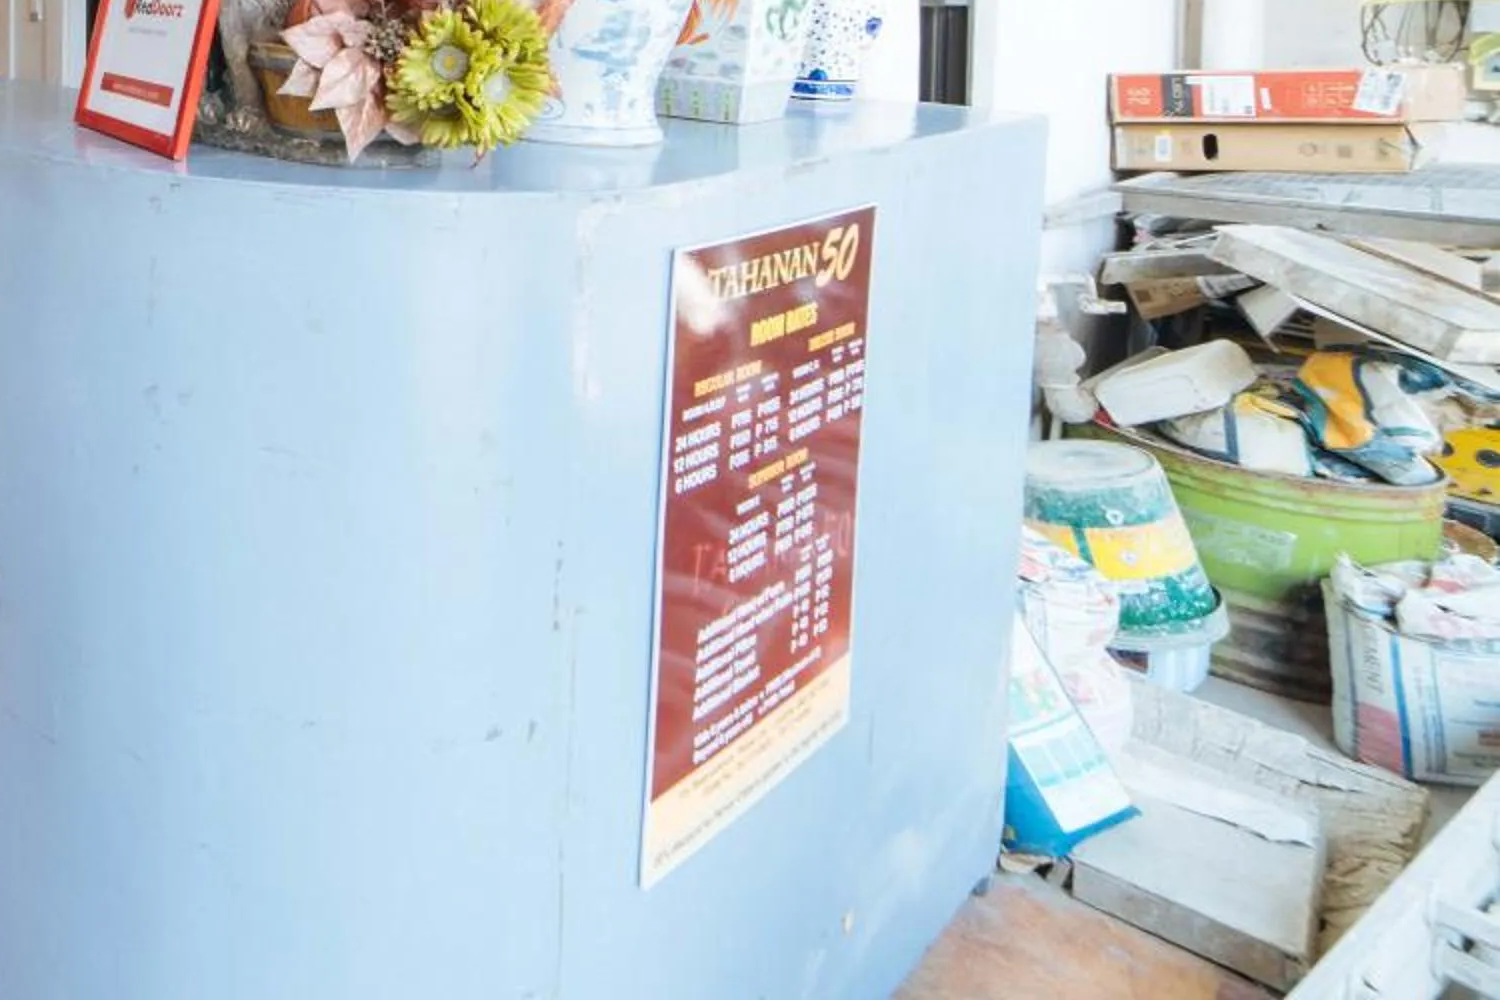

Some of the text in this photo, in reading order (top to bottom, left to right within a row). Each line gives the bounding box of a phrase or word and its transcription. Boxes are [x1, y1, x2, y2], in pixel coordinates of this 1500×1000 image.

[708, 223, 859, 300] TAHANAN 50
[687, 421, 721, 448] HOURS
[685, 442, 719, 470] HOURS
[683, 463, 717, 491] HOURS
